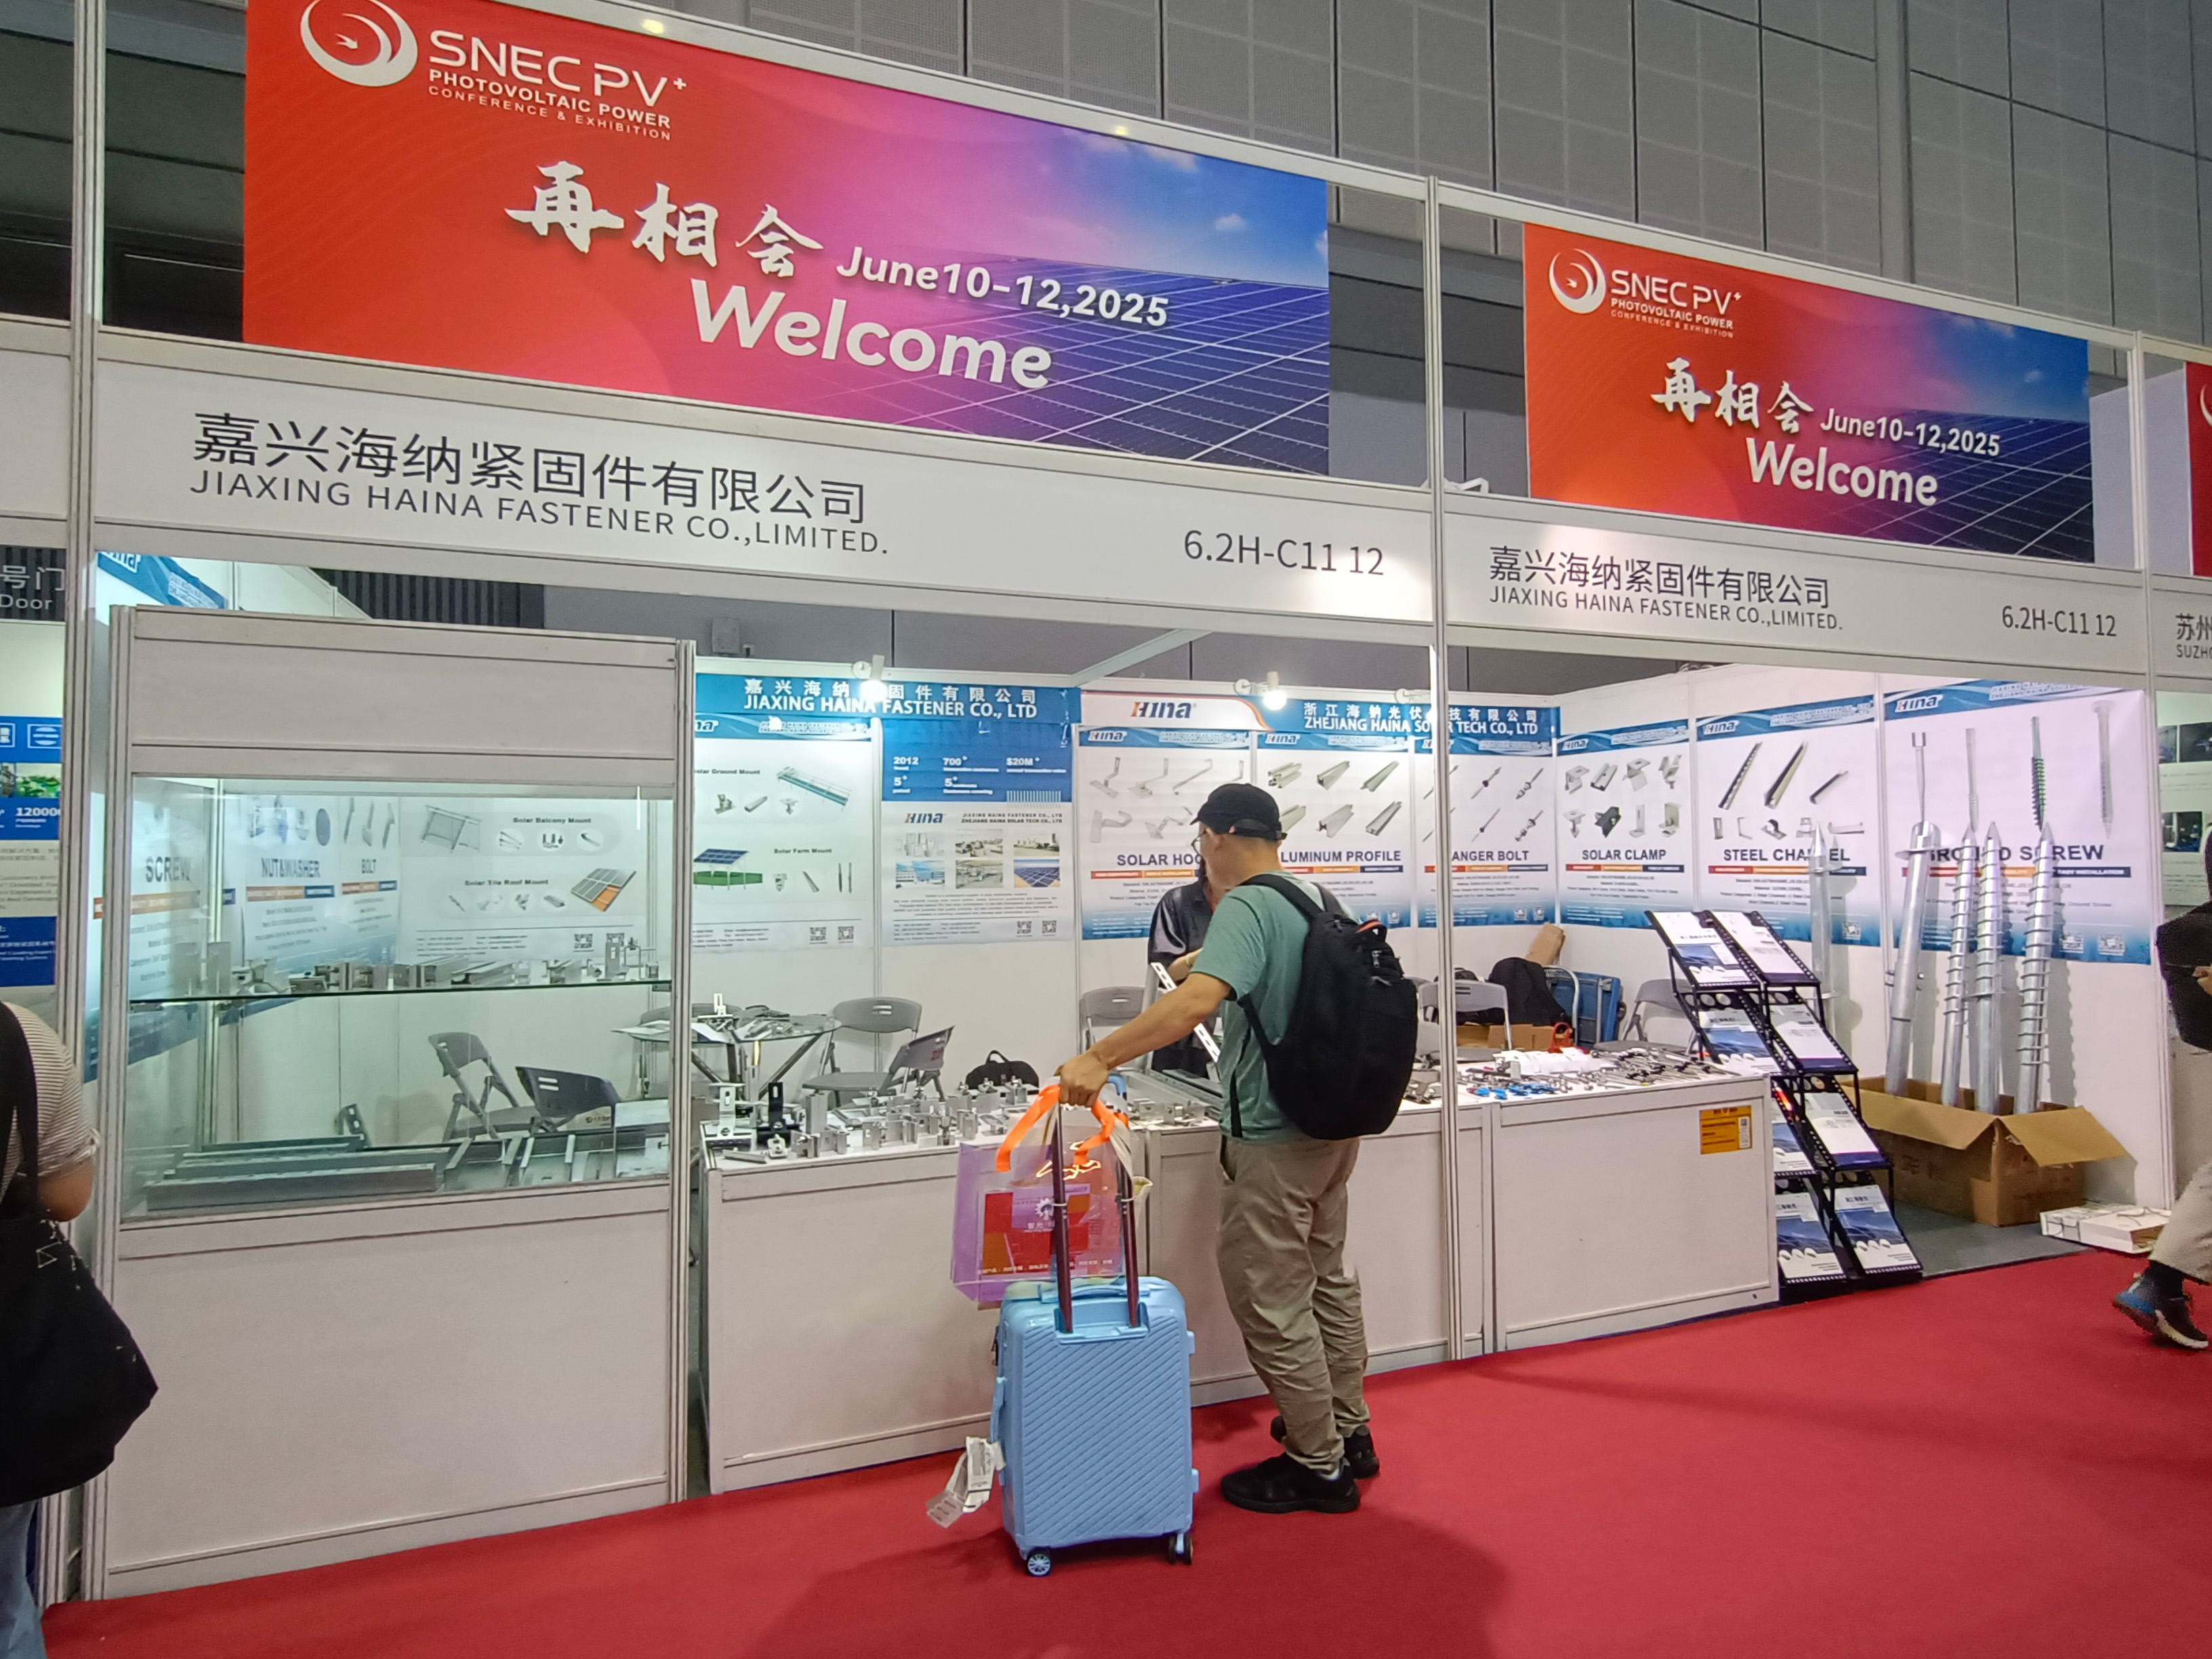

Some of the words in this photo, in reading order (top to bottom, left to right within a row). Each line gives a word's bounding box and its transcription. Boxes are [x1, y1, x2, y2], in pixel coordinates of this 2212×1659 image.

[429, 30, 581, 93] SNEC
[428, 68, 591, 113] PHOTOVOLTAIC
[599, 102, 671, 129] POWER
[428, 86, 548, 119] CONFERENCE
[556, 110, 566, 121] &
[575, 115, 672, 141] EXHIBITION
[504, 161, 824, 279] 再相会
[836, 246, 1170, 327] June10-12,2025
[1610, 269, 1688, 308] SNEC
[691, 278, 1052, 389] Welcome
[1610, 298, 1693, 322] PHOTOVOLTAIC
[1696, 314, 1734, 330] POWER
[1610, 309, 1671, 328] CONFERENCE
[1683, 324, 1734, 339] EXHIBITION
[1650, 356, 1814, 434] 再相会
[1820, 408, 2001, 457] June10-12,2025
[193, 412, 865, 525] 嘉兴海纳紧固件有限公司
[1745, 437, 1938, 507] Welcome
[190, 470, 350, 507] JIAXING
[367, 485, 484, 519] HAINA
[497, 497, 674, 536] FASTENER
[687, 515, 888, 555] CO.,LIMITED.
[0, 565, 65, 591] 号门
[1489, 545, 1830, 609] 嘉兴海纳紧固件有限公司
[0, 594, 53, 609] Door
[1490, 586, 1568, 608] JIAXING
[1575, 592, 1634, 614] HAINA
[1640, 598, 1731, 622] FASTENER
[1736, 605, 1843, 630] CO.,LIMITED.
[743, 695, 815, 712] JIAXING
[821, 697, 876, 713] HAINA
[882, 699, 965, 716] FASTENER
[970, 702, 1003, 720] CO.,
[1007, 703, 1038, 718] LTD
[744, 678, 1036, 704] 嘉兴海纳固件有限公司
[1304, 716, 1368, 731] ZHEJIANG
[1371, 719, 1412, 733] HAINA
[1456, 721, 1487, 734] TECH
[1517, 722, 1538, 735] LTD
[893, 756, 919, 765] 2012
[1117, 854, 1168, 866] SOLAR
[1280, 851, 1343, 863] LUMINUM
[1346, 851, 1401, 862] PROFILE
[1451, 851, 1495, 861] ANGER
[1498, 850, 1530, 861] BOLT
[1582, 849, 1622, 861] SOLAR
[1624, 848, 1666, 861] CLAMP
[1723, 848, 1768, 861] STEEL
